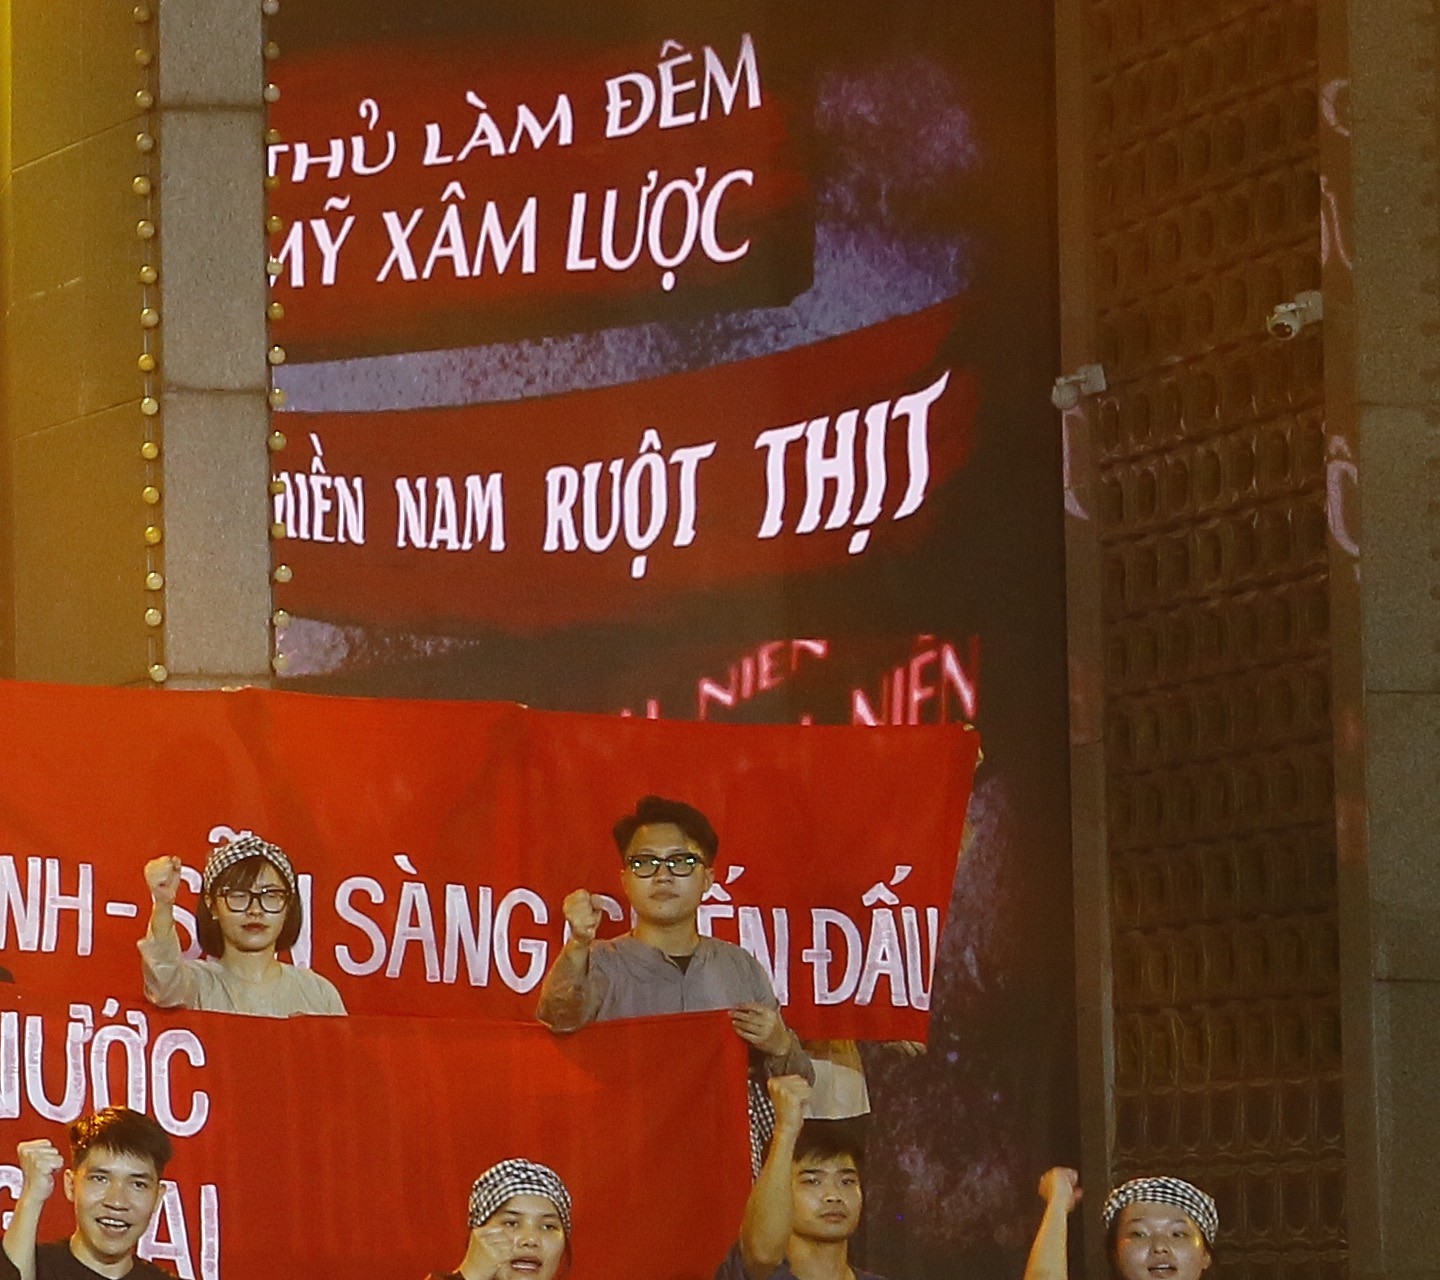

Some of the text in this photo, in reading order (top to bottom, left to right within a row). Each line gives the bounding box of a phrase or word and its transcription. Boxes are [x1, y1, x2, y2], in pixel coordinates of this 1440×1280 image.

[423, 91, 574, 167] LÀM
[604, 33, 763, 140] ĐÊM
[376, 182, 538, 284] XÂM
[565, 168, 754, 291] LƯỢC
[396, 471, 506, 553] NAM
[542, 430, 717, 579] RUỘT
[754, 370, 952, 555] THỊT
[332, 853, 550, 995] SÀNG
[801, 864, 940, 1011] ĐẤU
